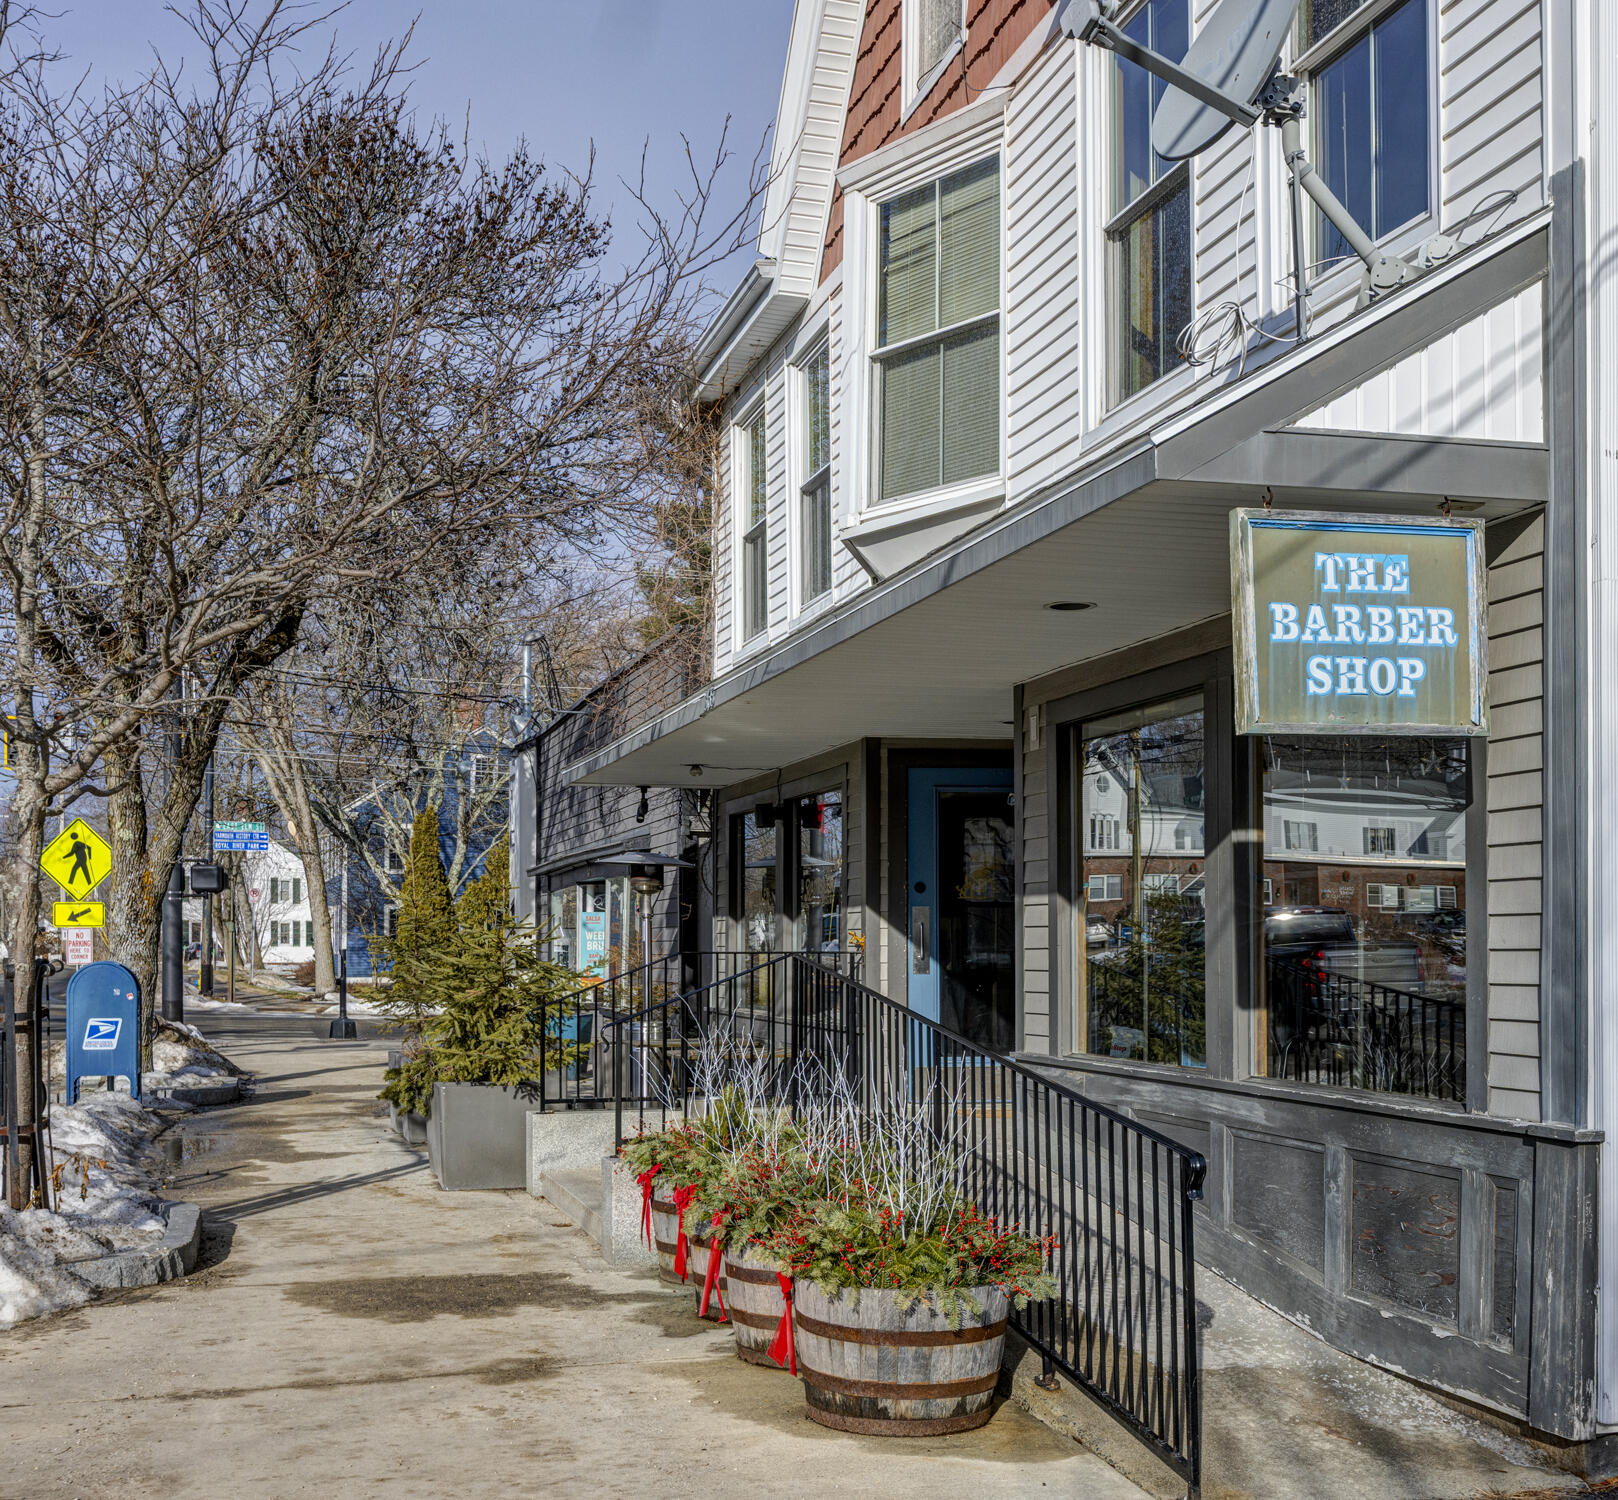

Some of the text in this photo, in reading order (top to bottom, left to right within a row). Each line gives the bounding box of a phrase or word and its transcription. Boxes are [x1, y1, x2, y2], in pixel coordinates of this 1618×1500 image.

[1315, 552, 1410, 593] THE
[1269, 602, 1459, 647] BARBER
[1306, 655, 1426, 697] SHOP
